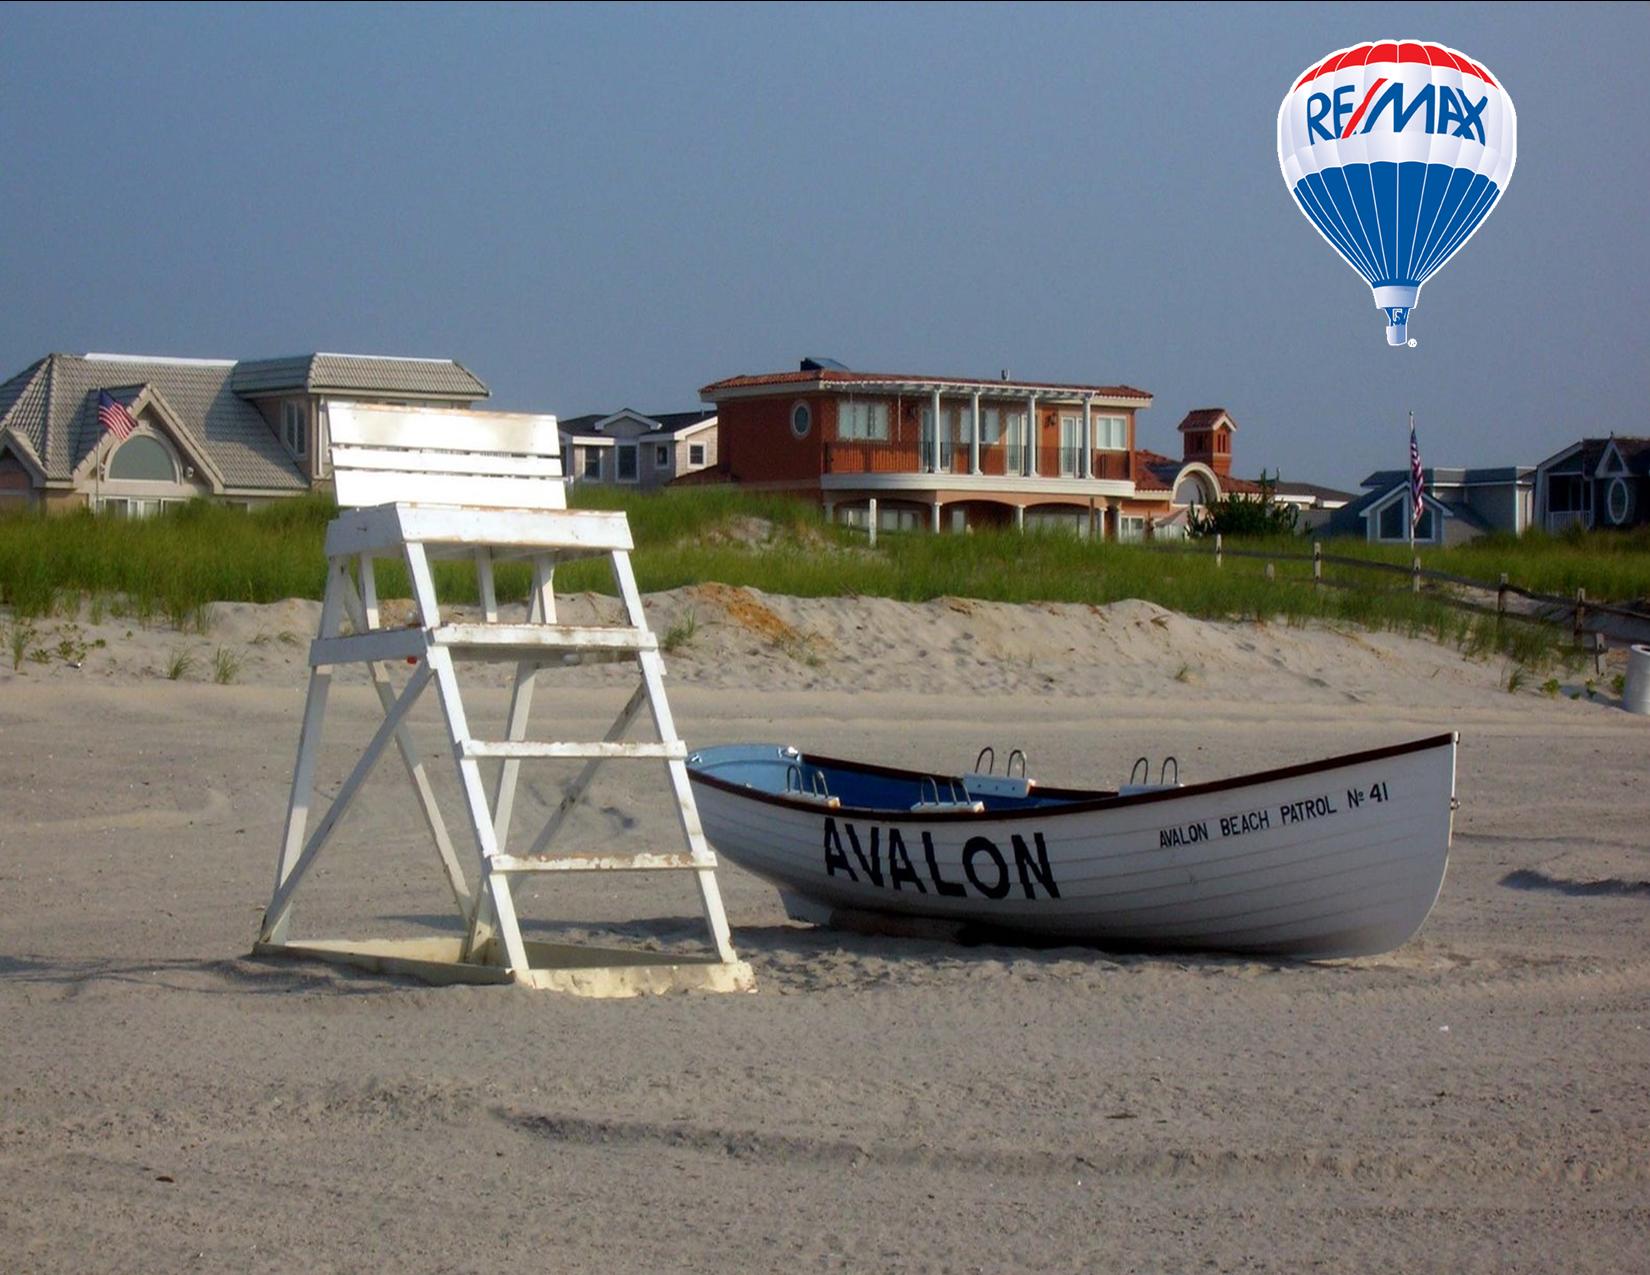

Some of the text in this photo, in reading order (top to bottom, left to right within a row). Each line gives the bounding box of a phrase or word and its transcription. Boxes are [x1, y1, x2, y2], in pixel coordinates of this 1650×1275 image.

[1159, 824, 1209, 848] AVALON
[1220, 811, 1270, 837] BEACH
[1280, 796, 1337, 825] PATROL
[1369, 782, 1388, 802] 41
[824, 817, 1061, 900] AVALON
